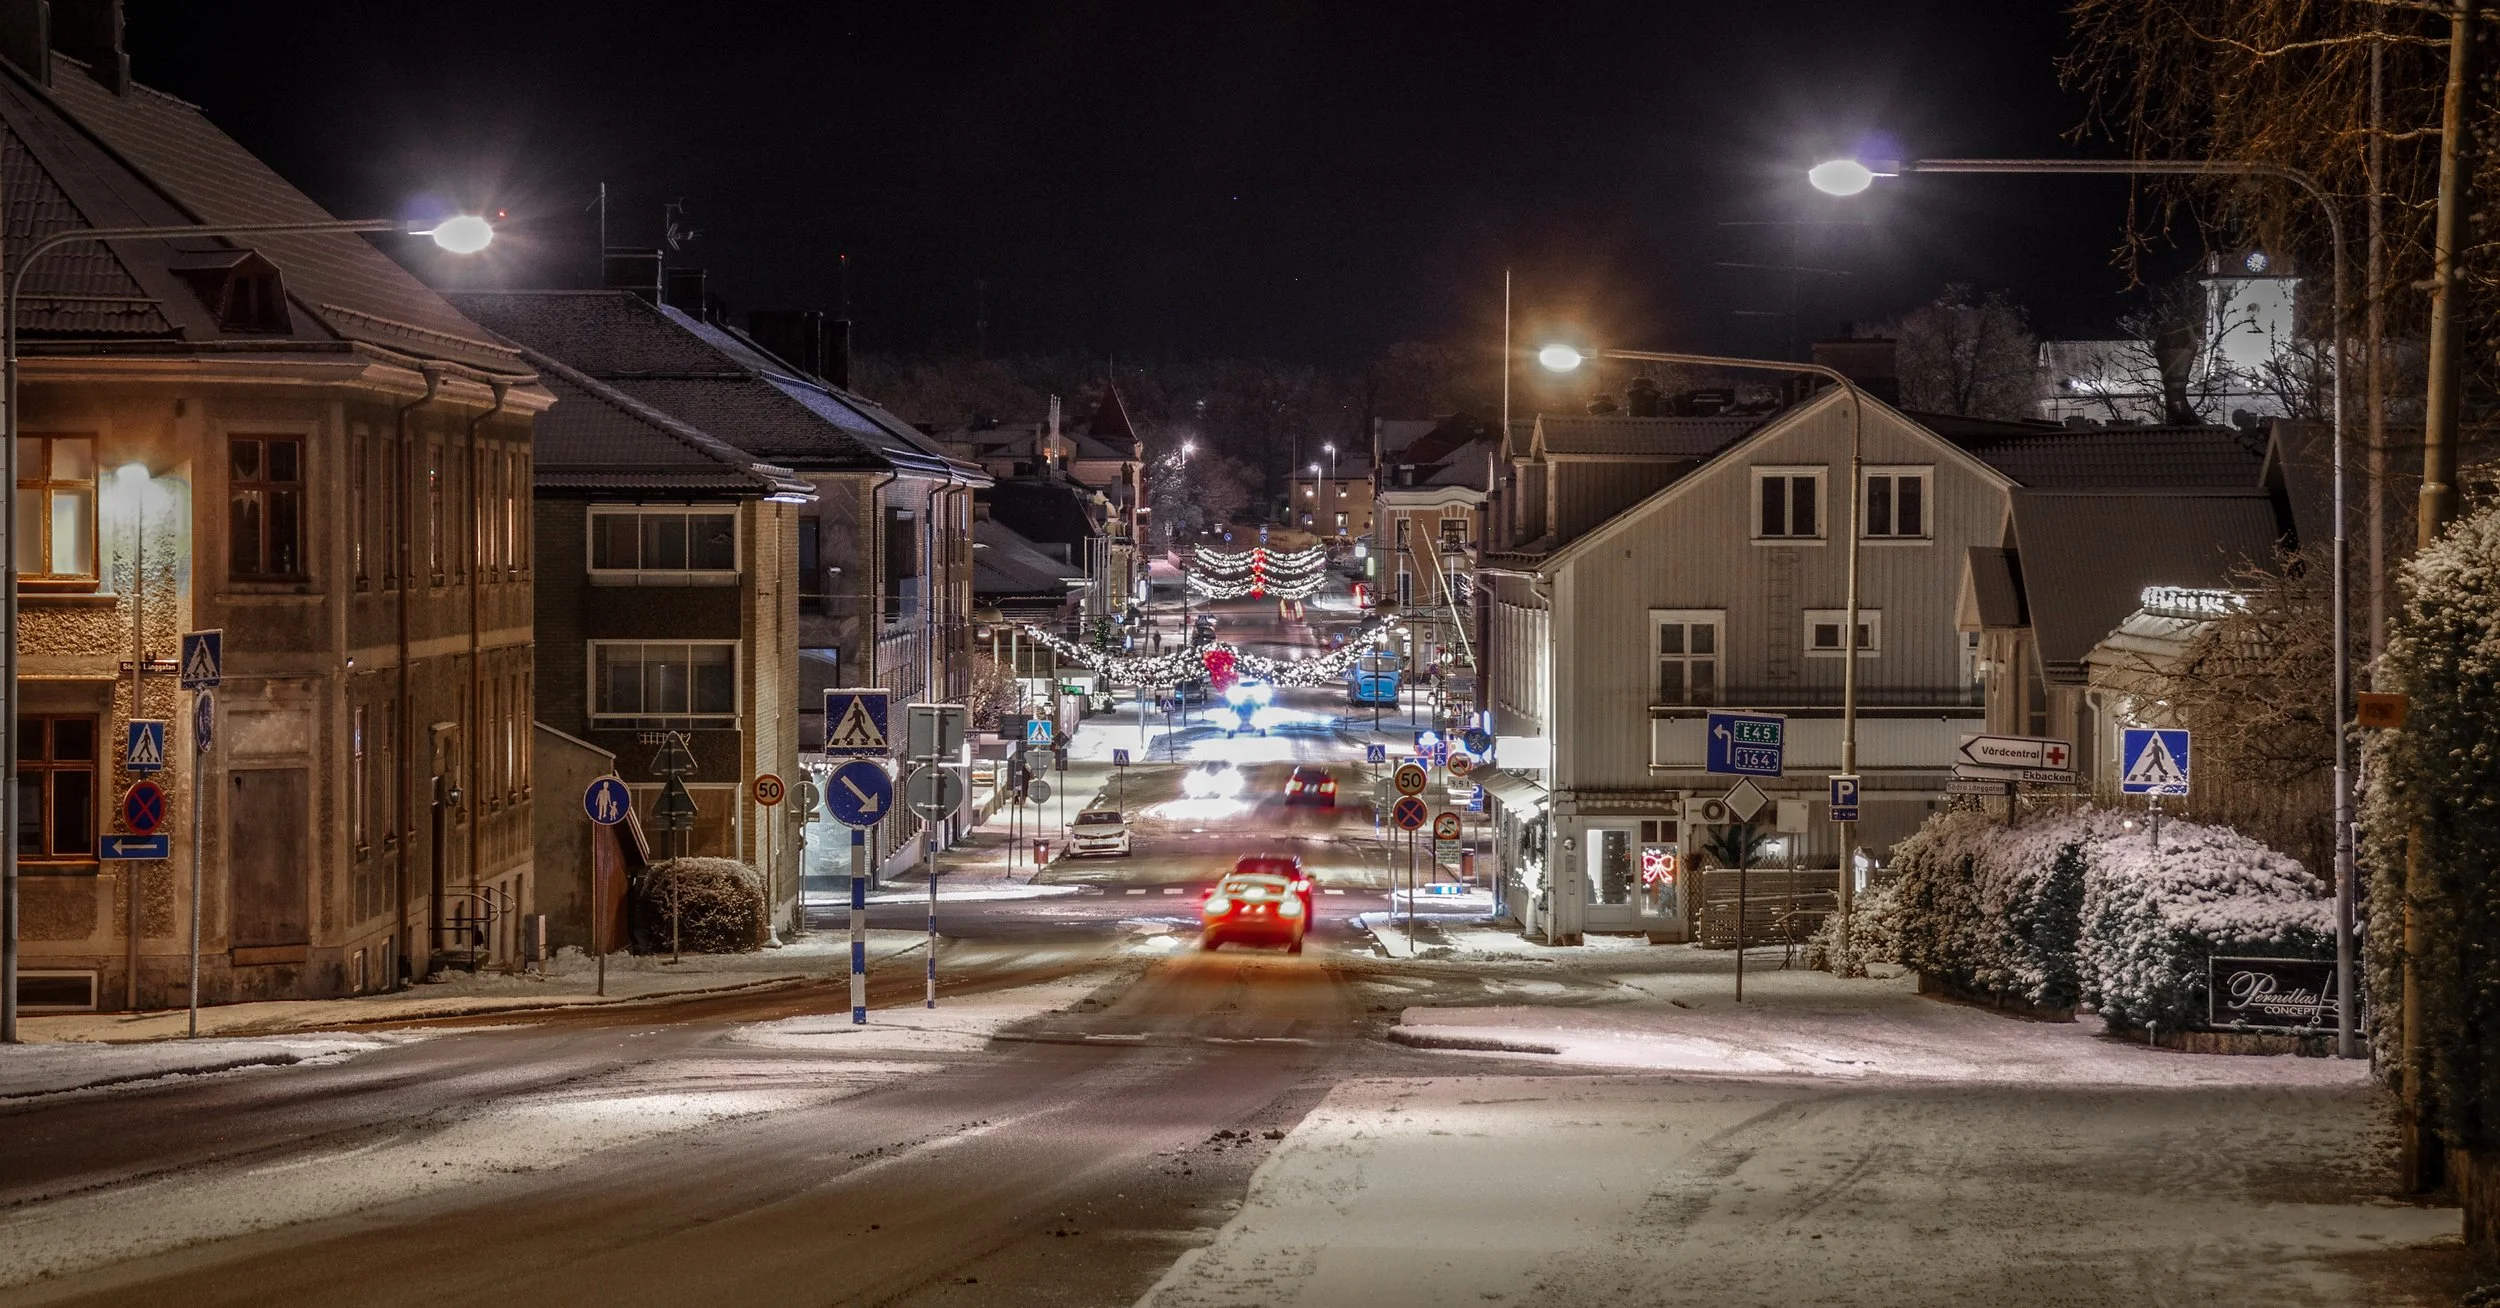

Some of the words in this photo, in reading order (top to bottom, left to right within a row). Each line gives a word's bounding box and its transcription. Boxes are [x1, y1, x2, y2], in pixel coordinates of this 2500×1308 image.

[1743, 726, 1771, 739] E45
[1437, 742, 1445, 753] P
[1981, 745, 2040, 759] Vårdcentral
[1744, 753, 1770, 766] 164
[1401, 772, 1422, 788] 50
[2023, 770, 2072, 782] Ekbacken
[759, 782, 780, 797] 50
[1451, 780, 1465, 789] 3,5
[1471, 785, 1480, 798] P
[1838, 781, 1854, 803] P
[2227, 970, 2318, 1009] Pernillas
[2264, 1005, 2317, 1015] CONCEPT
